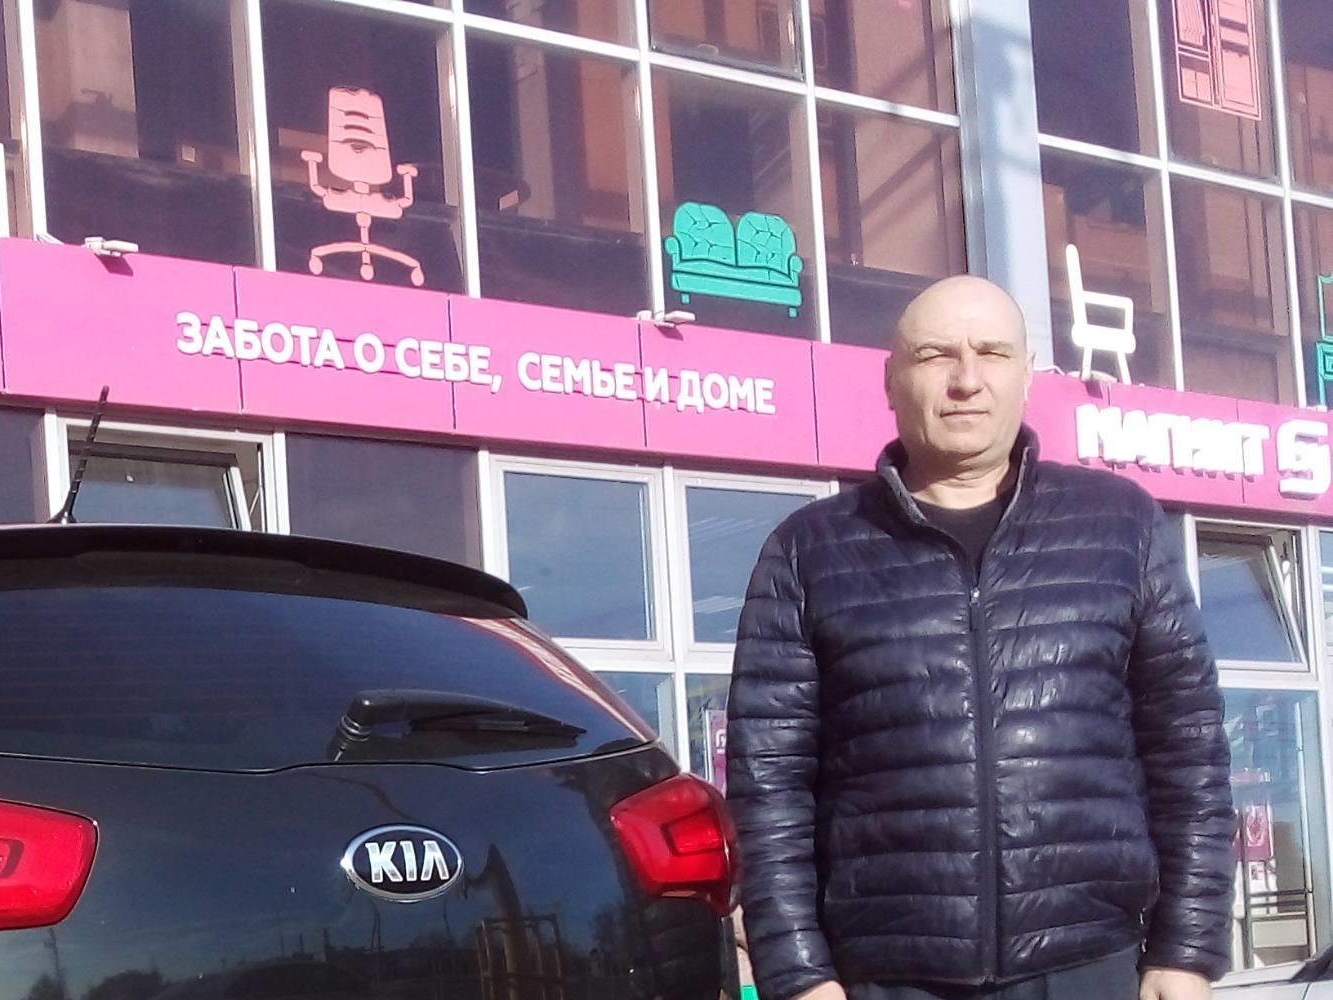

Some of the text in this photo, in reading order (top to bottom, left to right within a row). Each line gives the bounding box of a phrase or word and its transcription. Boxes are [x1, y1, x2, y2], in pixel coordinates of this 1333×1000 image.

[176, 312, 777, 414] ЗАБОТА О СЕБЕ, СЕМЬЕ И ДОМЕ
[364, 840, 450, 883] KIA
